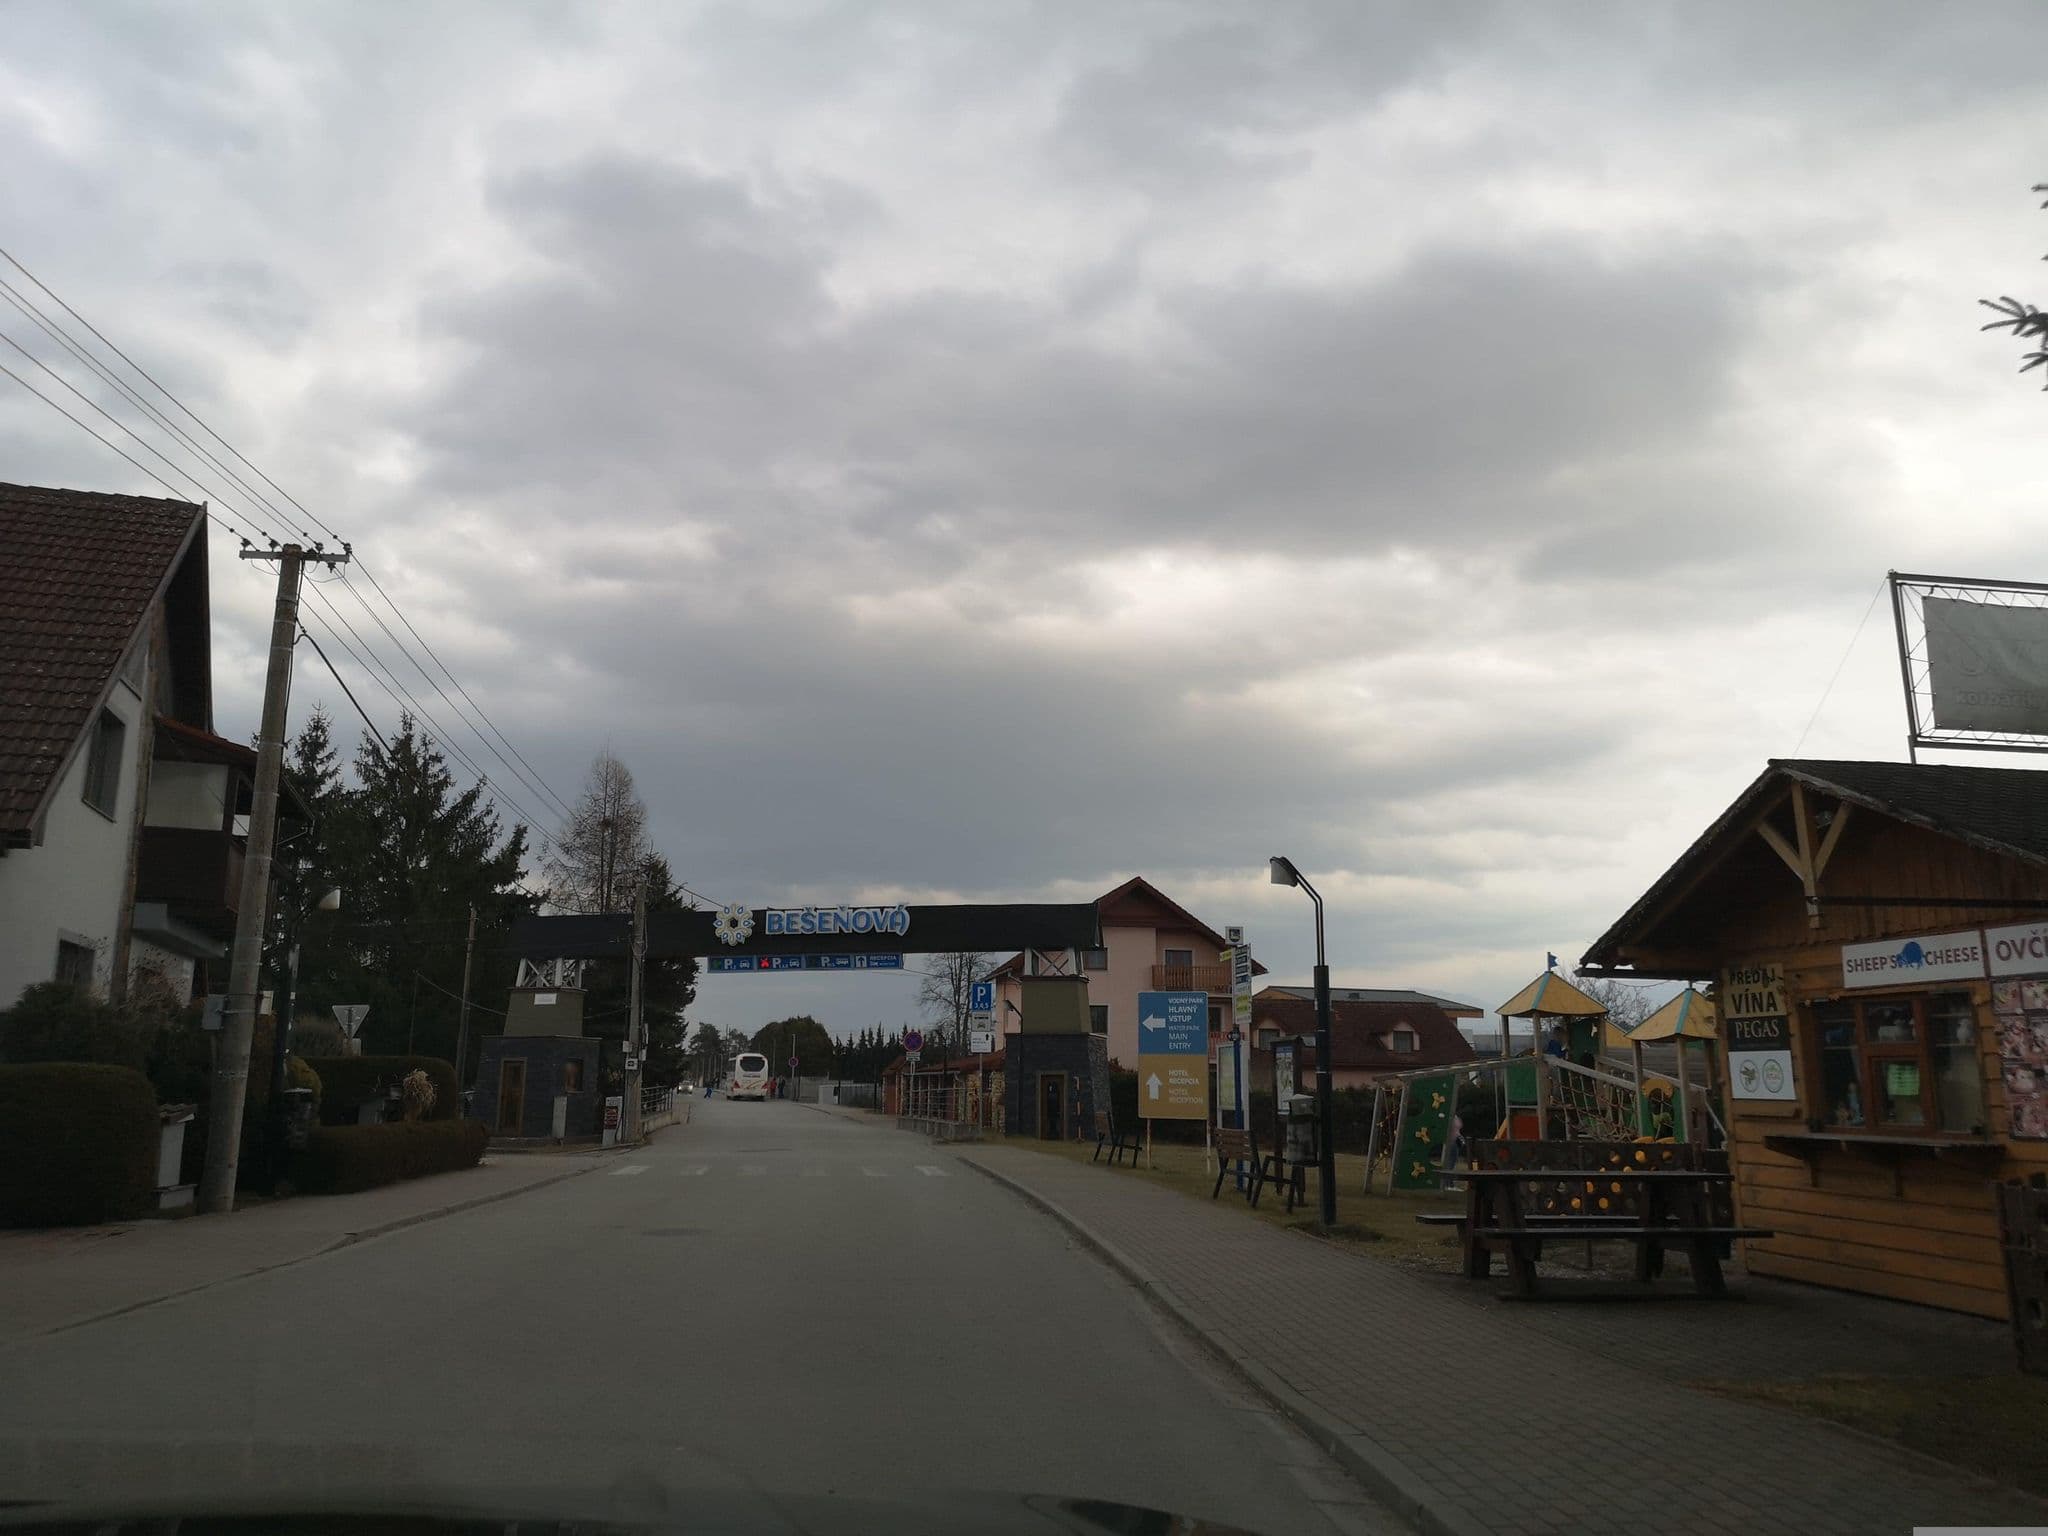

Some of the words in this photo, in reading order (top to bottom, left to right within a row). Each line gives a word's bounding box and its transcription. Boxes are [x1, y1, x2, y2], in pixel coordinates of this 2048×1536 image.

[766, 905, 910, 936] BEŠEŇOVÁ
[1925, 946, 1979, 966] CHEESE
[977, 986, 986, 1002] P
[1731, 988, 1778, 1014] VÍNA
[1168, 1004, 1198, 1013] HLAVNÝ
[1735, 1018, 1781, 1038] PEGAS
[1168, 1042, 1192, 1050] ENTRY
